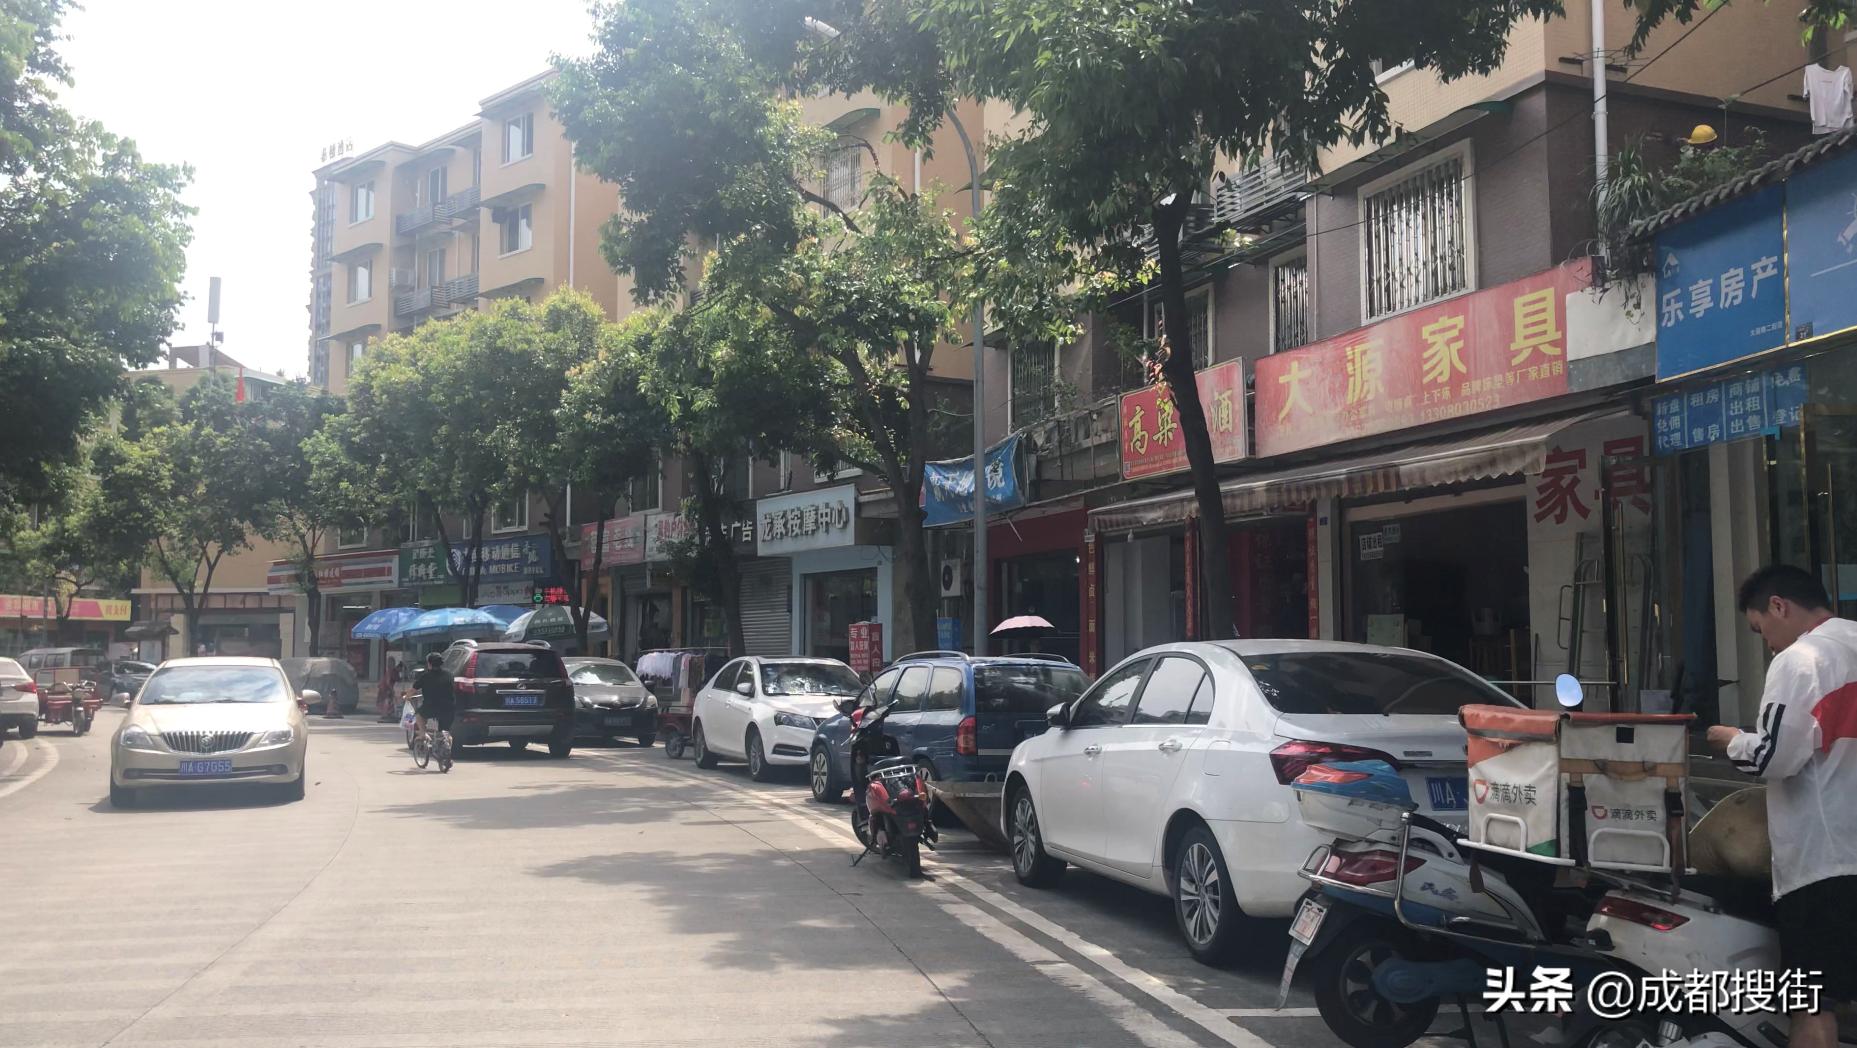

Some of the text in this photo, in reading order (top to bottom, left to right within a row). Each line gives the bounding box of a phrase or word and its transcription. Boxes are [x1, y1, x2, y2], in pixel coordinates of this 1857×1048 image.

[1661, 255, 1779, 328] 乐享房产
[1279, 287, 1562, 424] 大源家具
[1690, 388, 1719, 408] 租房
[1729, 379, 1760, 398] 商铺
[1730, 396, 1761, 415] 出租
[1731, 415, 1762, 433] 出售
[1534, 435, 1650, 525] 家具
[1490, 781, 1537, 806] 滴滴外卖
[1610, 808, 1657, 822] 滴滴外卖
